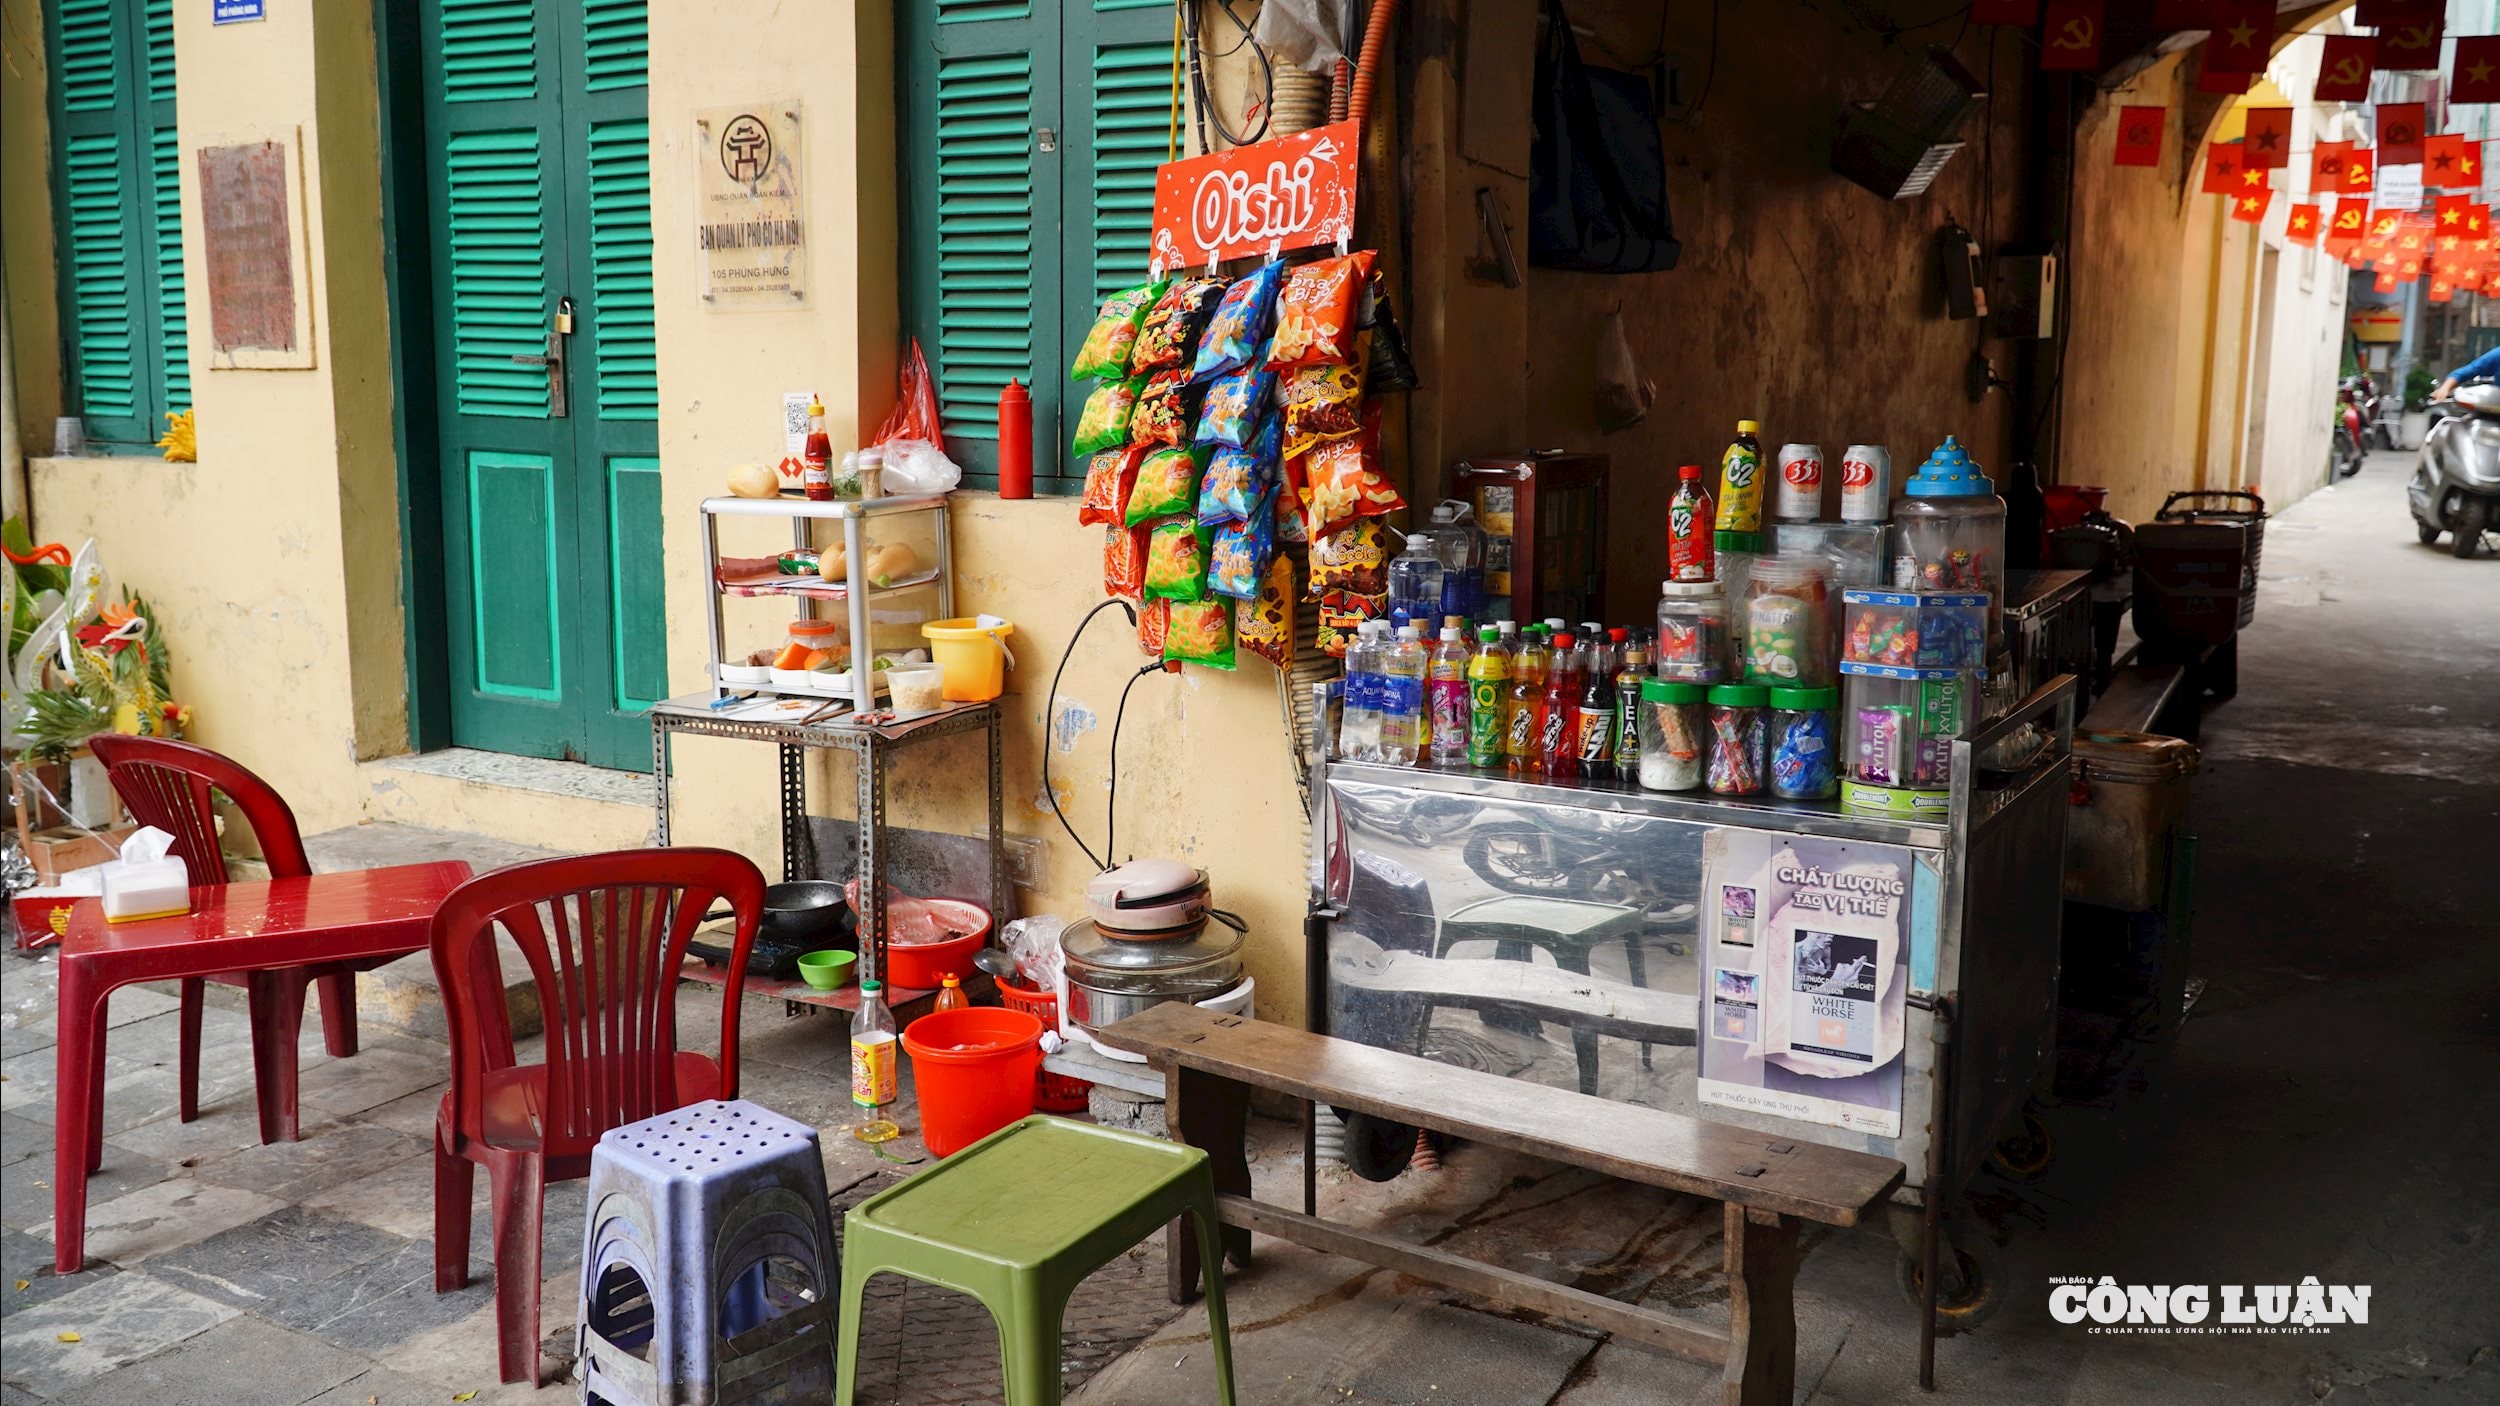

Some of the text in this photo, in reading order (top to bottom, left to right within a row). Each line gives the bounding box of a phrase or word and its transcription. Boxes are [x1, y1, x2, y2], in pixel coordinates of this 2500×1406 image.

[1192, 156, 1315, 250] Oishi
[700, 225, 715, 250] BAN
[712, 266, 790, 279] 105 PHÙNG HƯNG
[1727, 458, 1756, 487] C2
[1787, 458, 1819, 484] 333
[1671, 509, 1692, 537] C2
[1936, 738, 1950, 781] XYLITO
[1779, 865, 1905, 896] CHẤT LƯỢNG
[1794, 893, 1890, 917] TẠO VỊ THẾ
[1727, 921, 1748, 929] HORSE
[1728, 917, 1749, 925] WHITE
[1860, 982, 1875, 992] CHẾT
[1725, 1006, 1747, 1015] WHITE
[1812, 996, 1855, 1011] WHITE
[1724, 1011, 1747, 1019] HORSE
[1812, 1006, 1855, 1020] HORSE
[1710, 1090, 1723, 1099] HÚT
[1726, 1092, 1746, 1103] THUỐC
[1748, 1096, 1761, 1106] GÂY
